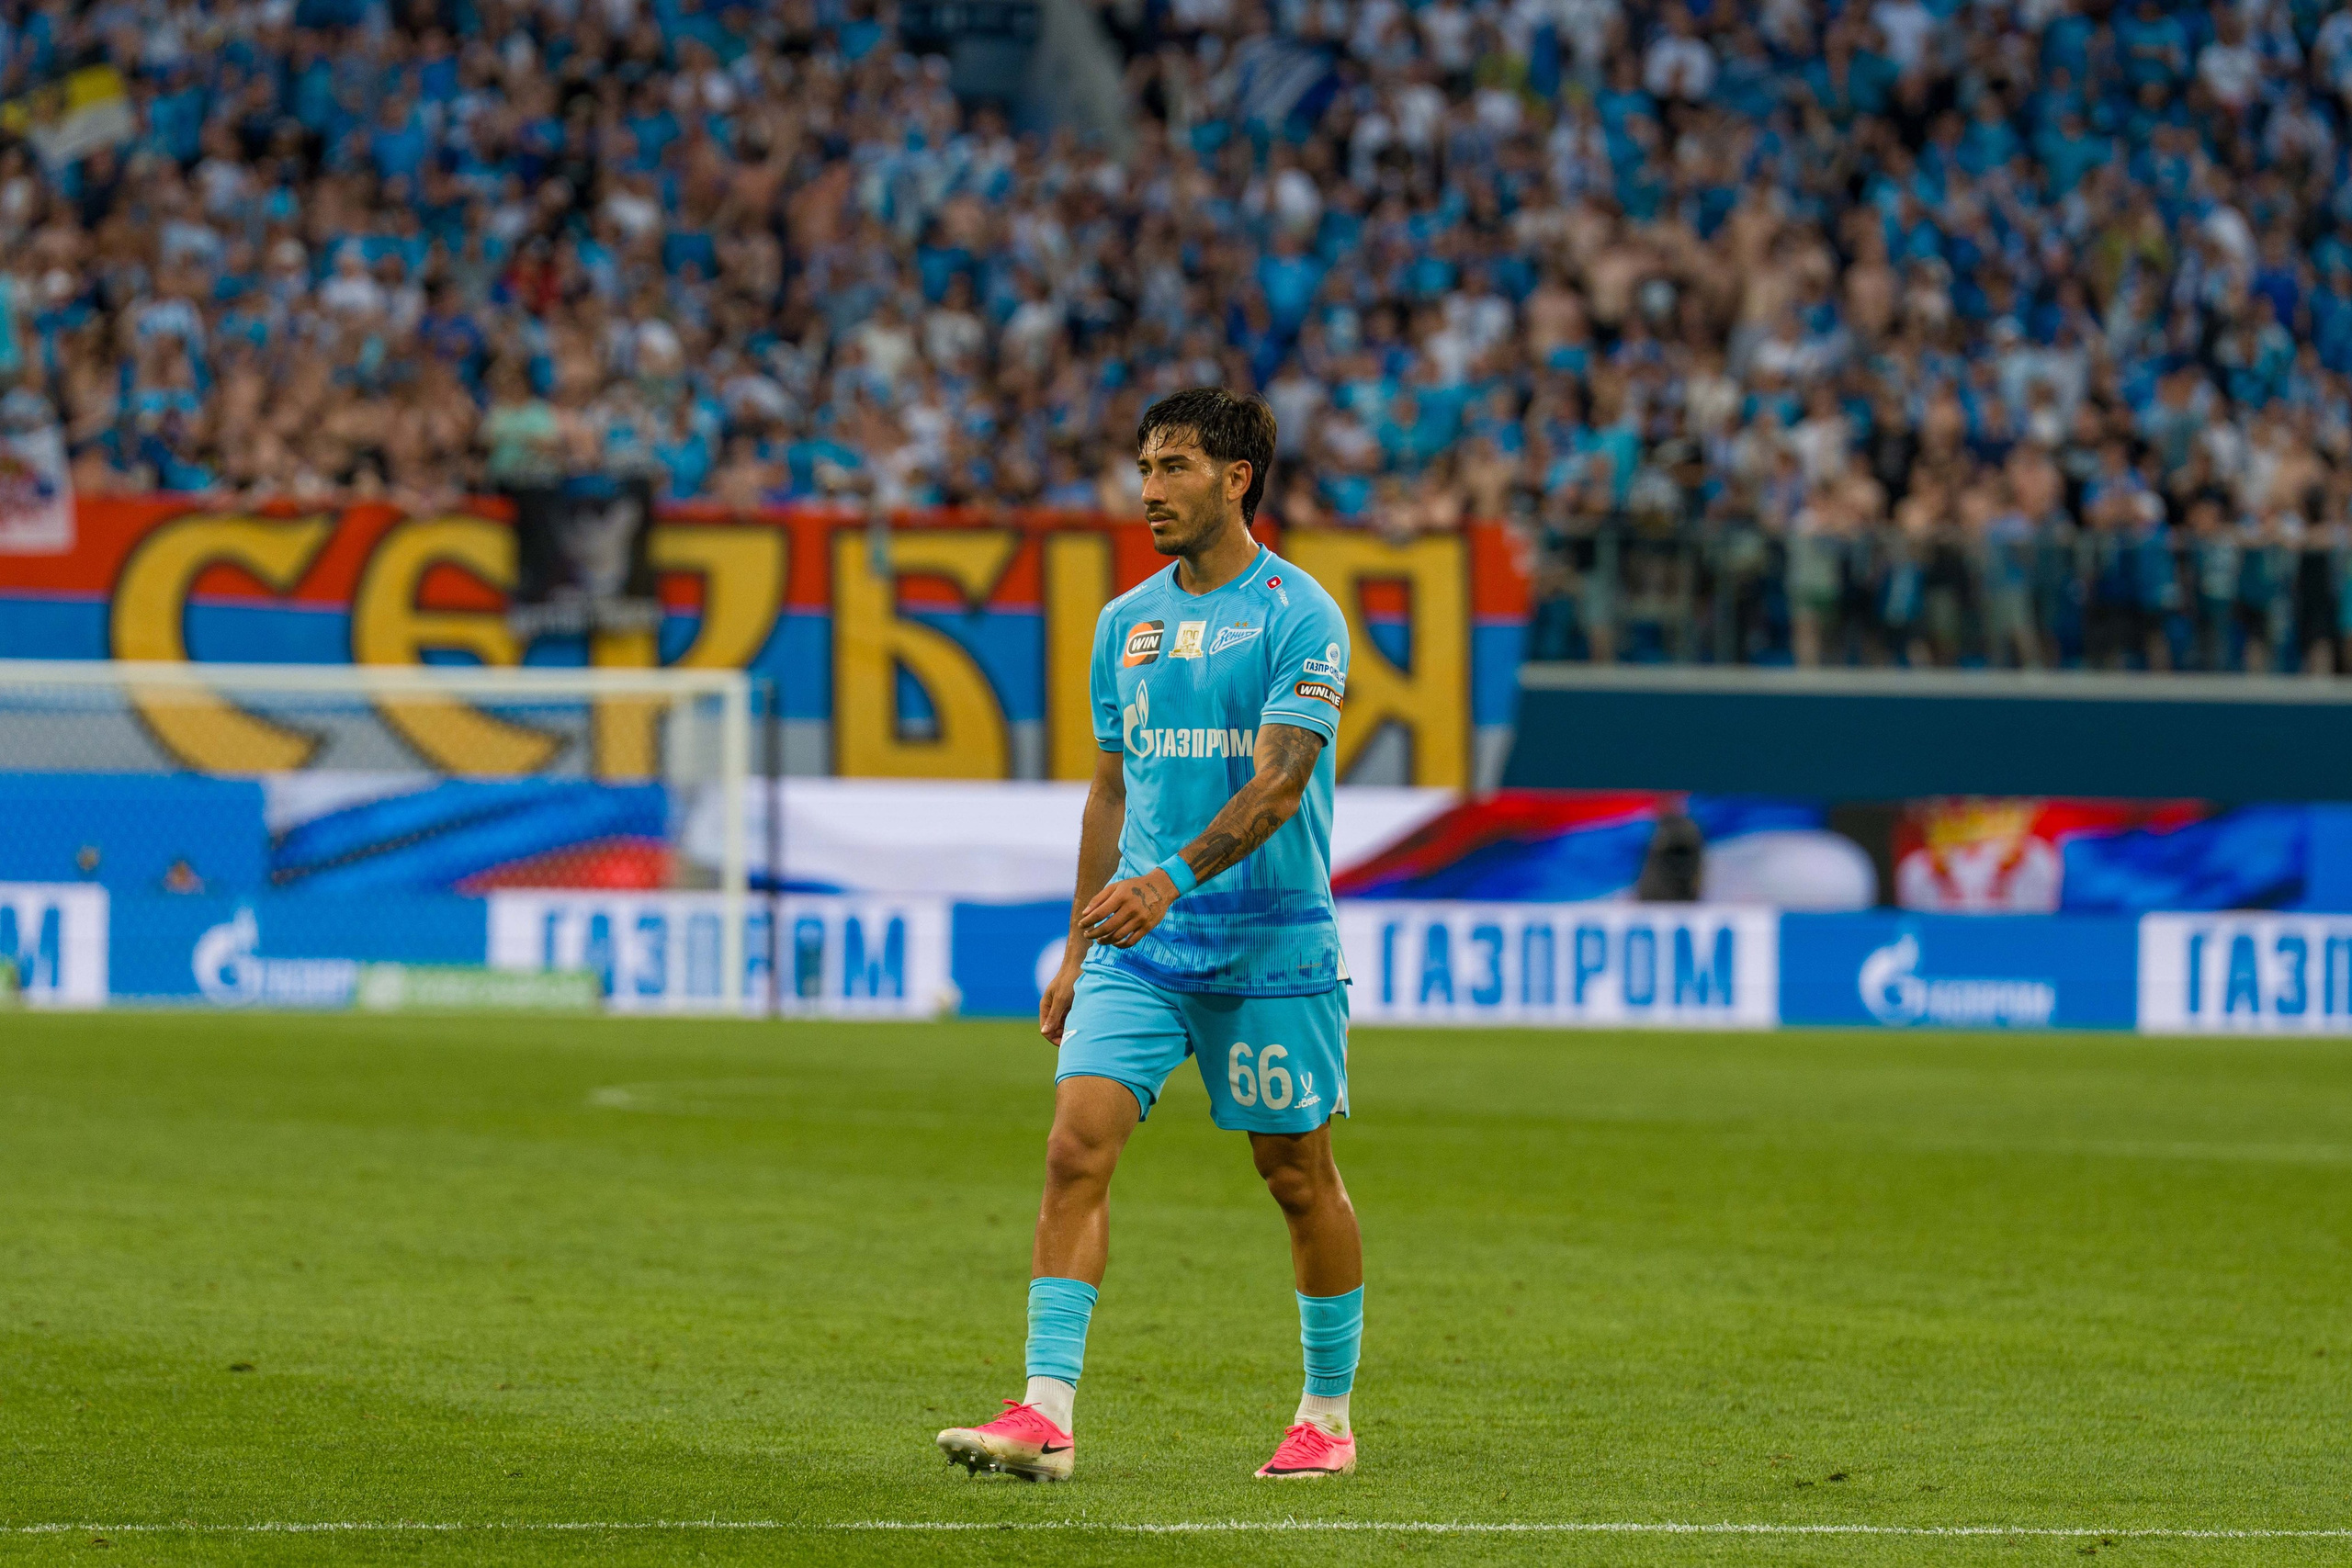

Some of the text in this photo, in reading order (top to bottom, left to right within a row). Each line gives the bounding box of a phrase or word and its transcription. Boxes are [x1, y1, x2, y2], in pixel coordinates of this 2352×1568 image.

[1131, 635, 1159, 651] WIN
[1155, 728, 1253, 758] ГАЗПРОМ
[1383, 922, 1733, 1007] ГАЗПРОМ
[1228, 1042, 1293, 1110] 66
